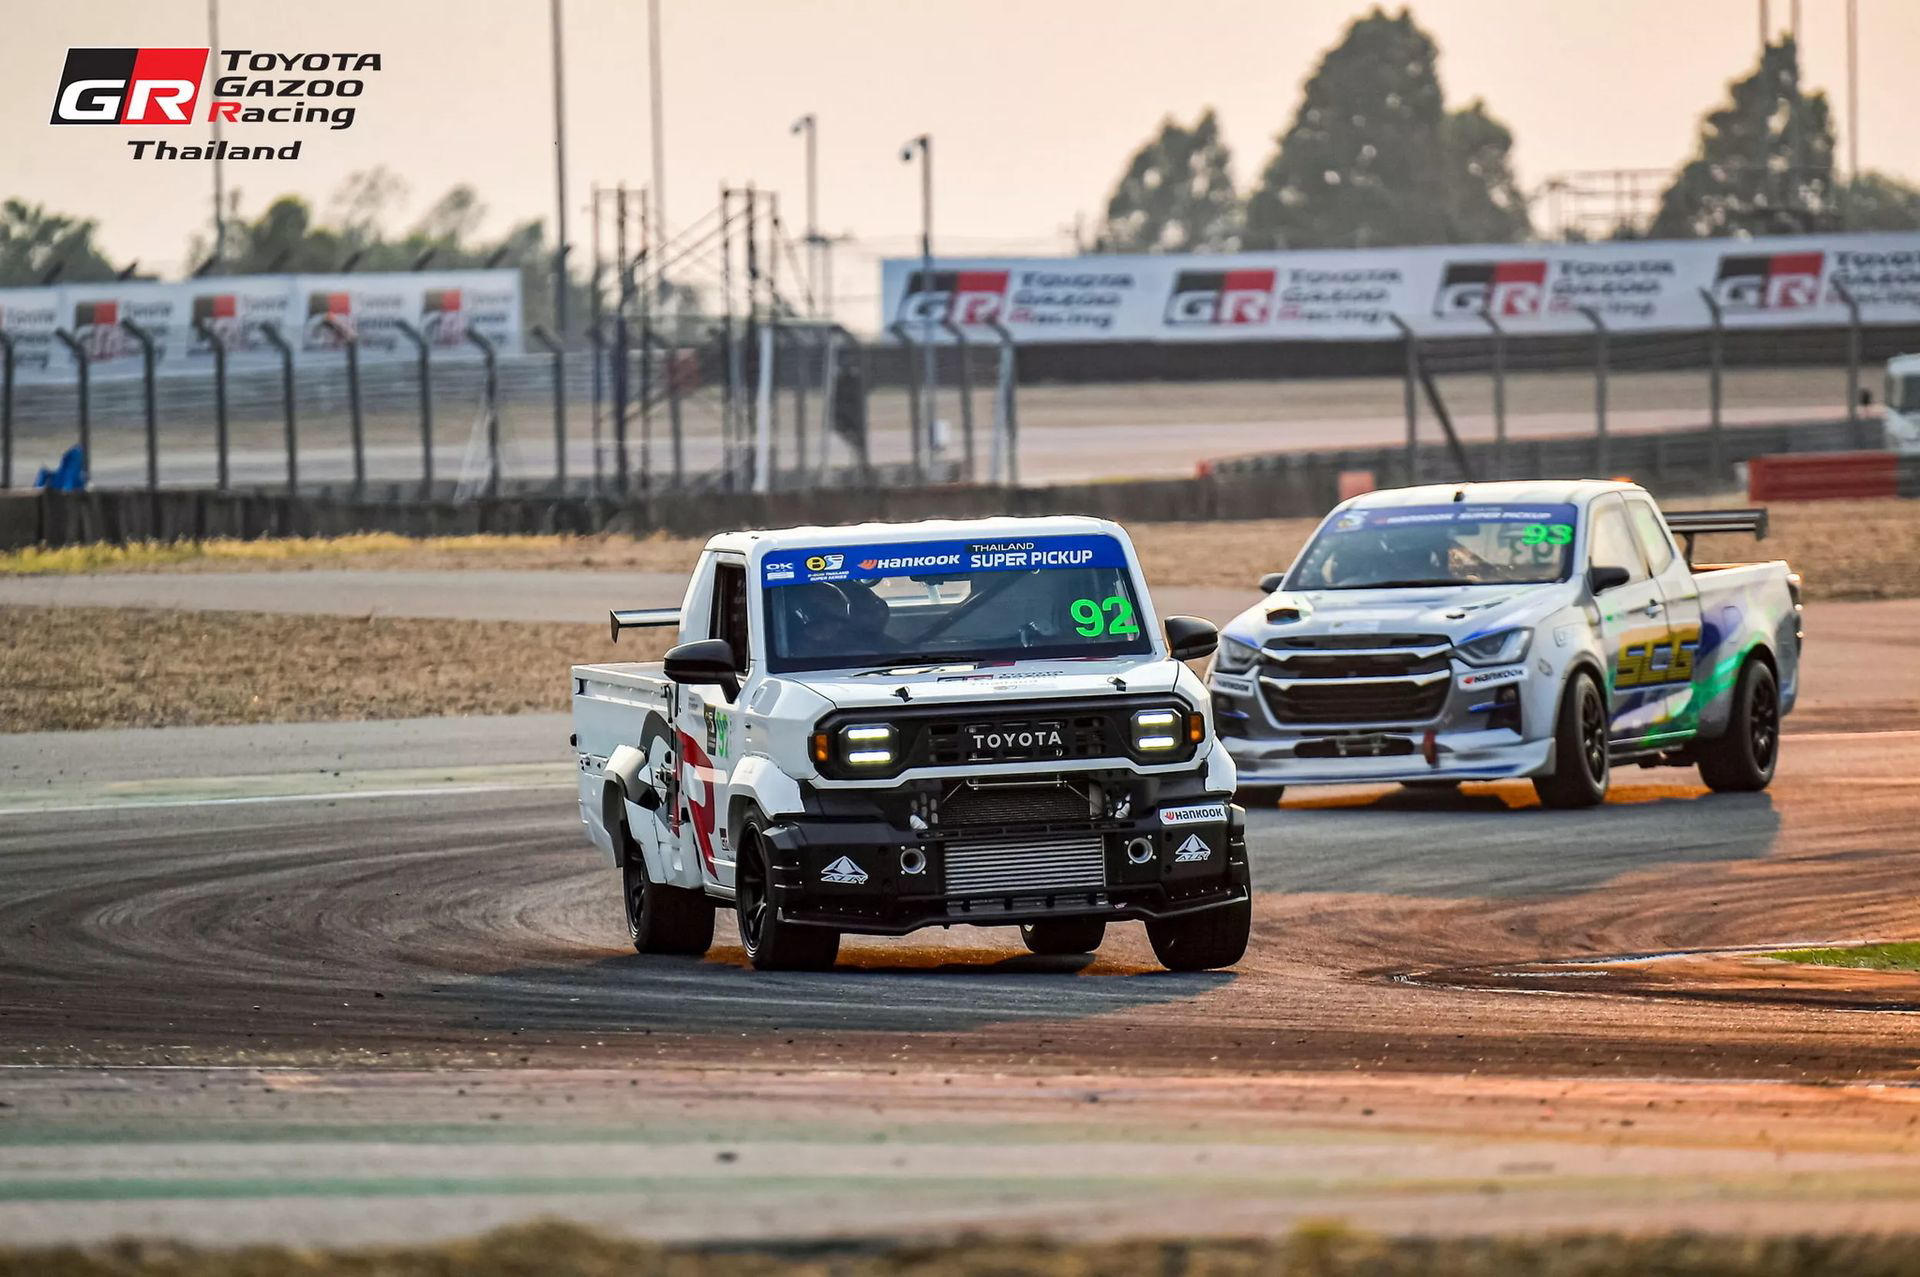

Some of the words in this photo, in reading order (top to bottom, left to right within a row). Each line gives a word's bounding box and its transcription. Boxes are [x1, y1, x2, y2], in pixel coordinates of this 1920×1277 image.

[1521, 523, 1574, 545] 93
[972, 542, 1035, 552] THAILAND
[766, 562, 794, 571] OK
[970, 552, 1027, 568] SUPER
[1031, 550, 1093, 566] PICKUP
[1070, 596, 1139, 637] 92
[972, 731, 1062, 749] TOYOTA
